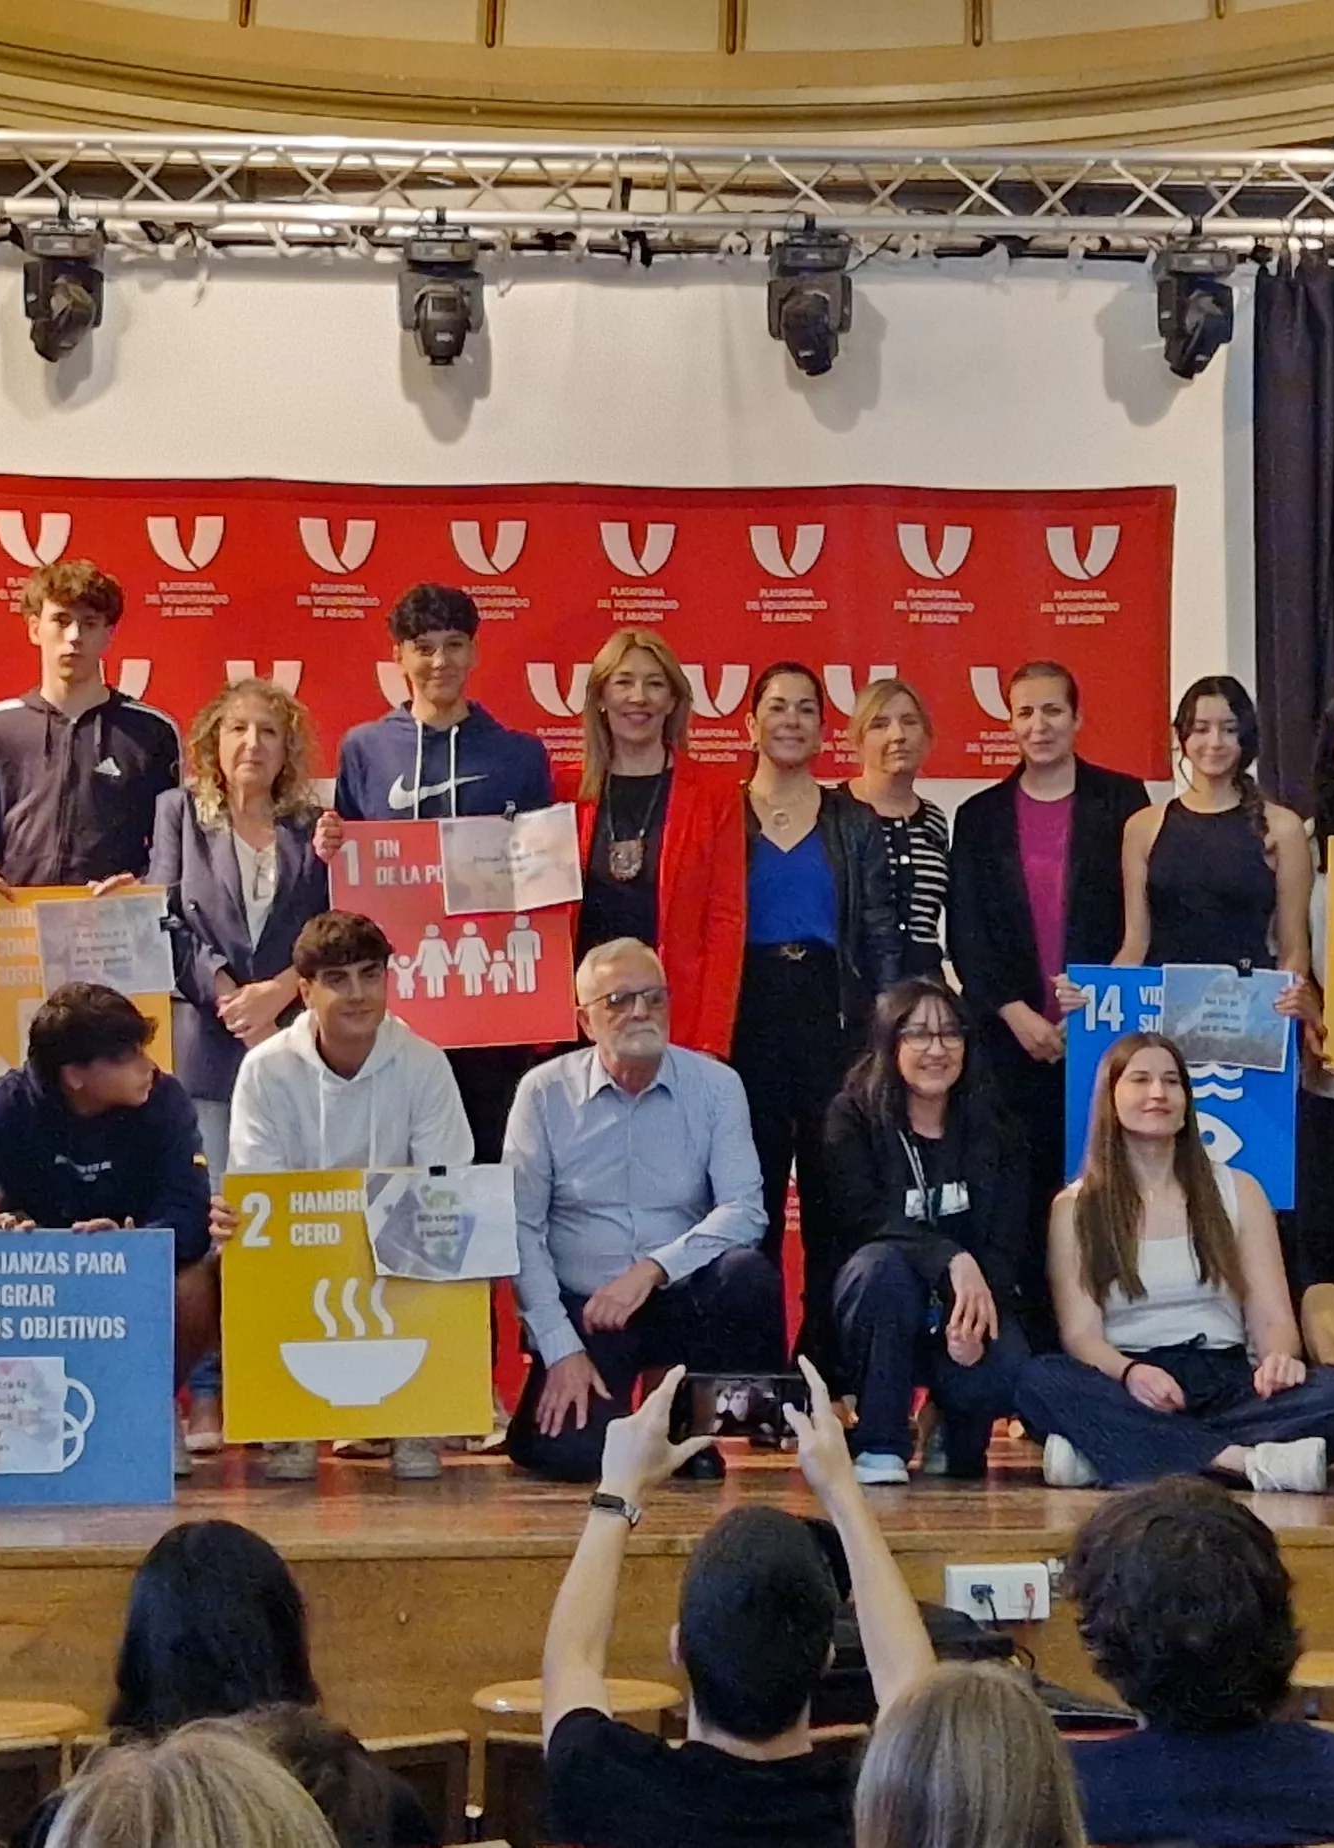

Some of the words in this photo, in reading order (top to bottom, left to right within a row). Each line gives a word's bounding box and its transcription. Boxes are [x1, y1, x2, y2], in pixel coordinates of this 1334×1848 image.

[374, 838, 401, 859] FIN
[339, 839, 360, 886] 1
[375, 866, 396, 887] DE
[400, 864, 423, 886] LA
[1080, 983, 1125, 1032] 14
[240, 1190, 273, 1248] 2
[289, 1222, 342, 1247] CERO
[74, 1251, 128, 1275] PARA
[19, 1315, 127, 1341] OBJETIVOS
